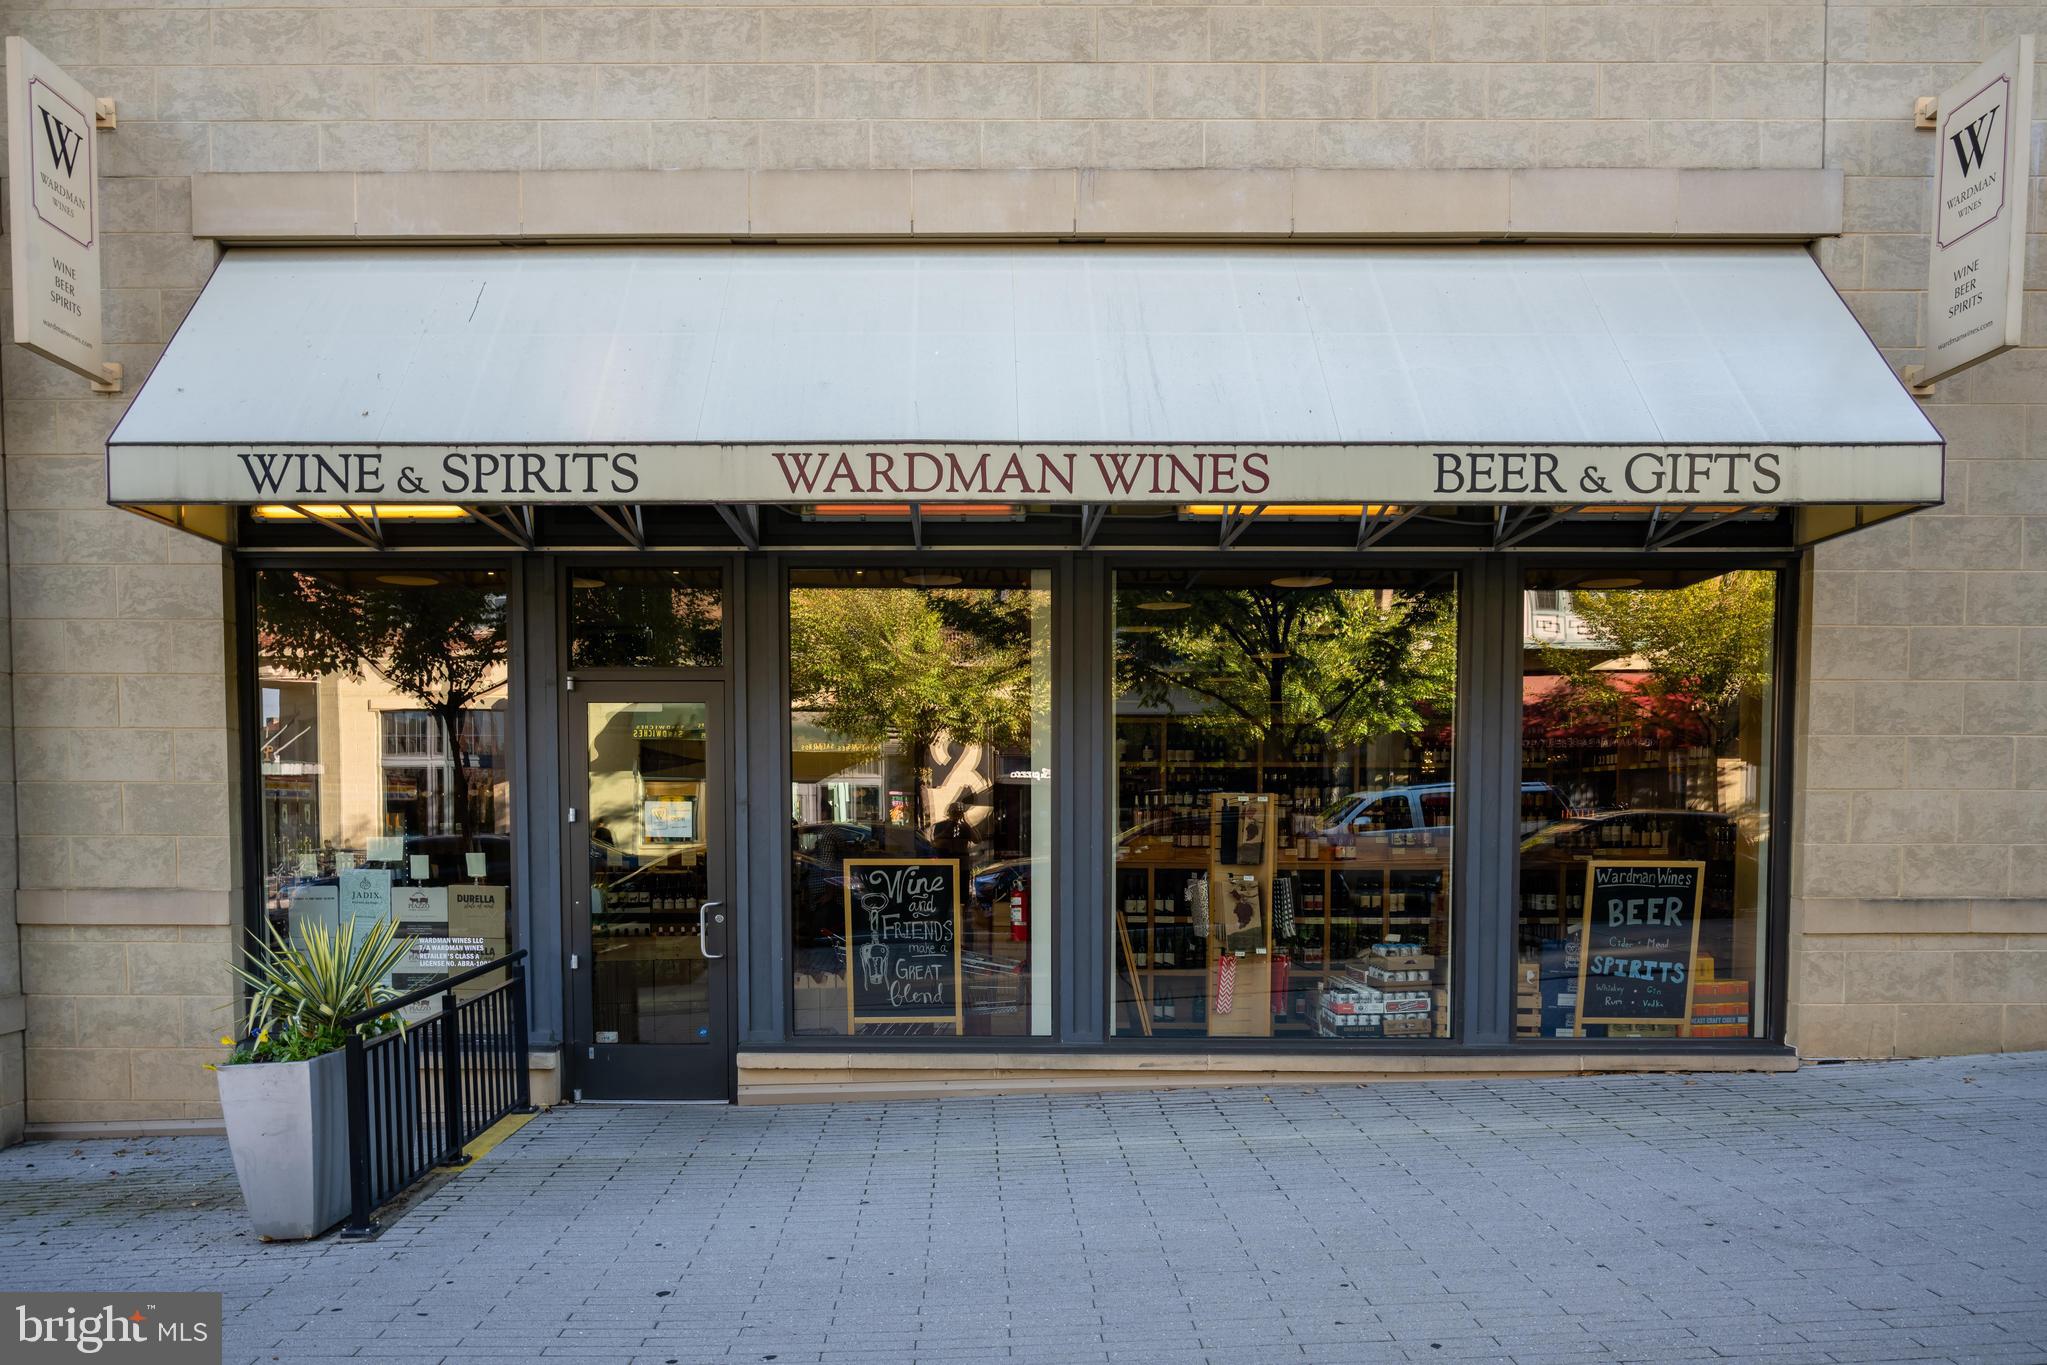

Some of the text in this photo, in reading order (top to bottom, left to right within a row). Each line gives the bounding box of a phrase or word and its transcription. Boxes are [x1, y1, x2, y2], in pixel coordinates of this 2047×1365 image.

[38, 104, 83, 179] W
[1950, 104, 2000, 178] W
[40, 171, 86, 210] WARDMAN
[1946, 171, 1997, 210] WARDMAN
[52, 197, 75, 218] WINES
[1957, 199, 1983, 219] WINES
[53, 257, 77, 280] WINE
[1953, 258, 1980, 281] WINE
[55, 276, 75, 297] BEER
[1954, 278, 1977, 299] BEER
[50, 290, 82, 317] SPIRITS
[1948, 292, 1983, 319] SPIRITS
[43, 319, 93, 350] wardmanwines.com
[1937, 320, 1994, 351] wardmanwines.com
[237, 453, 639, 495] WINE & SPIRITS
[771, 452, 1271, 495] WARDMAN WINES
[1432, 453, 1782, 494] BEER & GIFTS
[870, 866, 944, 903] Wine
[1596, 868, 1692, 885] Wardman Wines
[457, 894, 495, 904] DURELLA
[908, 895, 936, 912] and
[1608, 897, 1683, 927] BEER
[882, 914, 953, 941] FRIENDS
[908, 944, 948, 954] make a
[896, 959, 942, 981] GREAT
[1590, 955, 1685, 984] SPIRITS
[1605, 996, 1622, 1006] Rum
